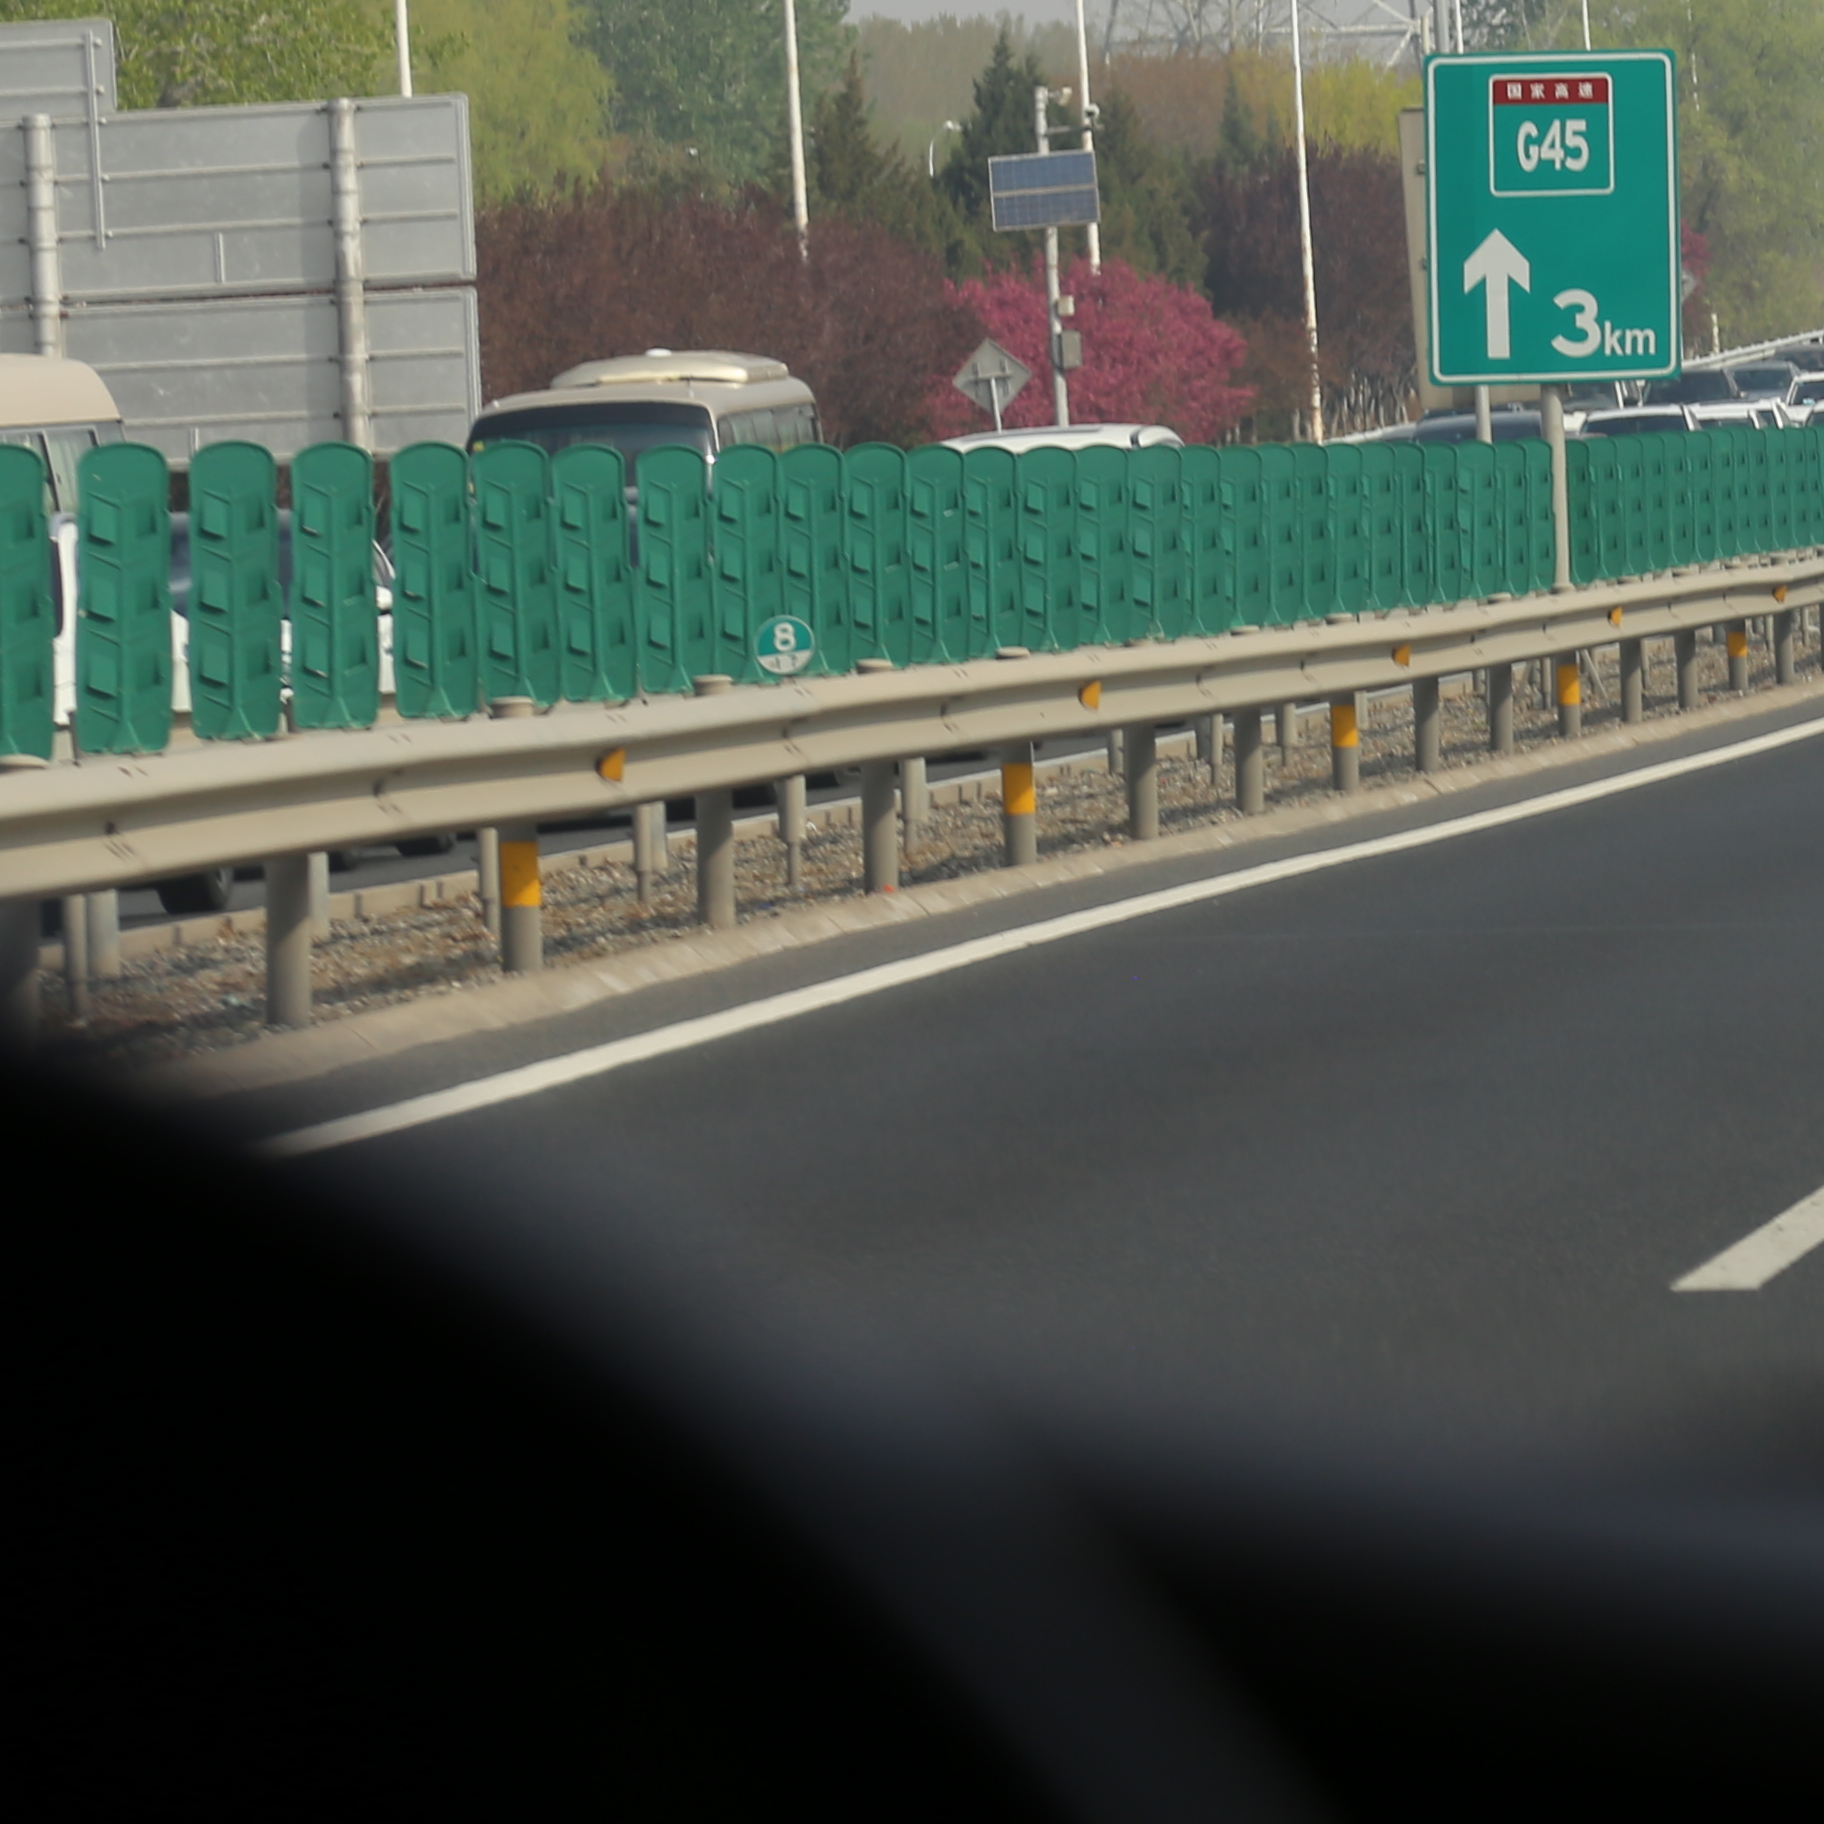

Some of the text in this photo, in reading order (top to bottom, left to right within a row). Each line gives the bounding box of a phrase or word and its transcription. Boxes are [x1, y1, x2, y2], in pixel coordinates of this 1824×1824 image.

[1507, 81, 1594, 100] 国家高速
[1516, 118, 1590, 173] G45
[1551, 287, 1656, 358] 3km
[773, 621, 797, 653] 8
